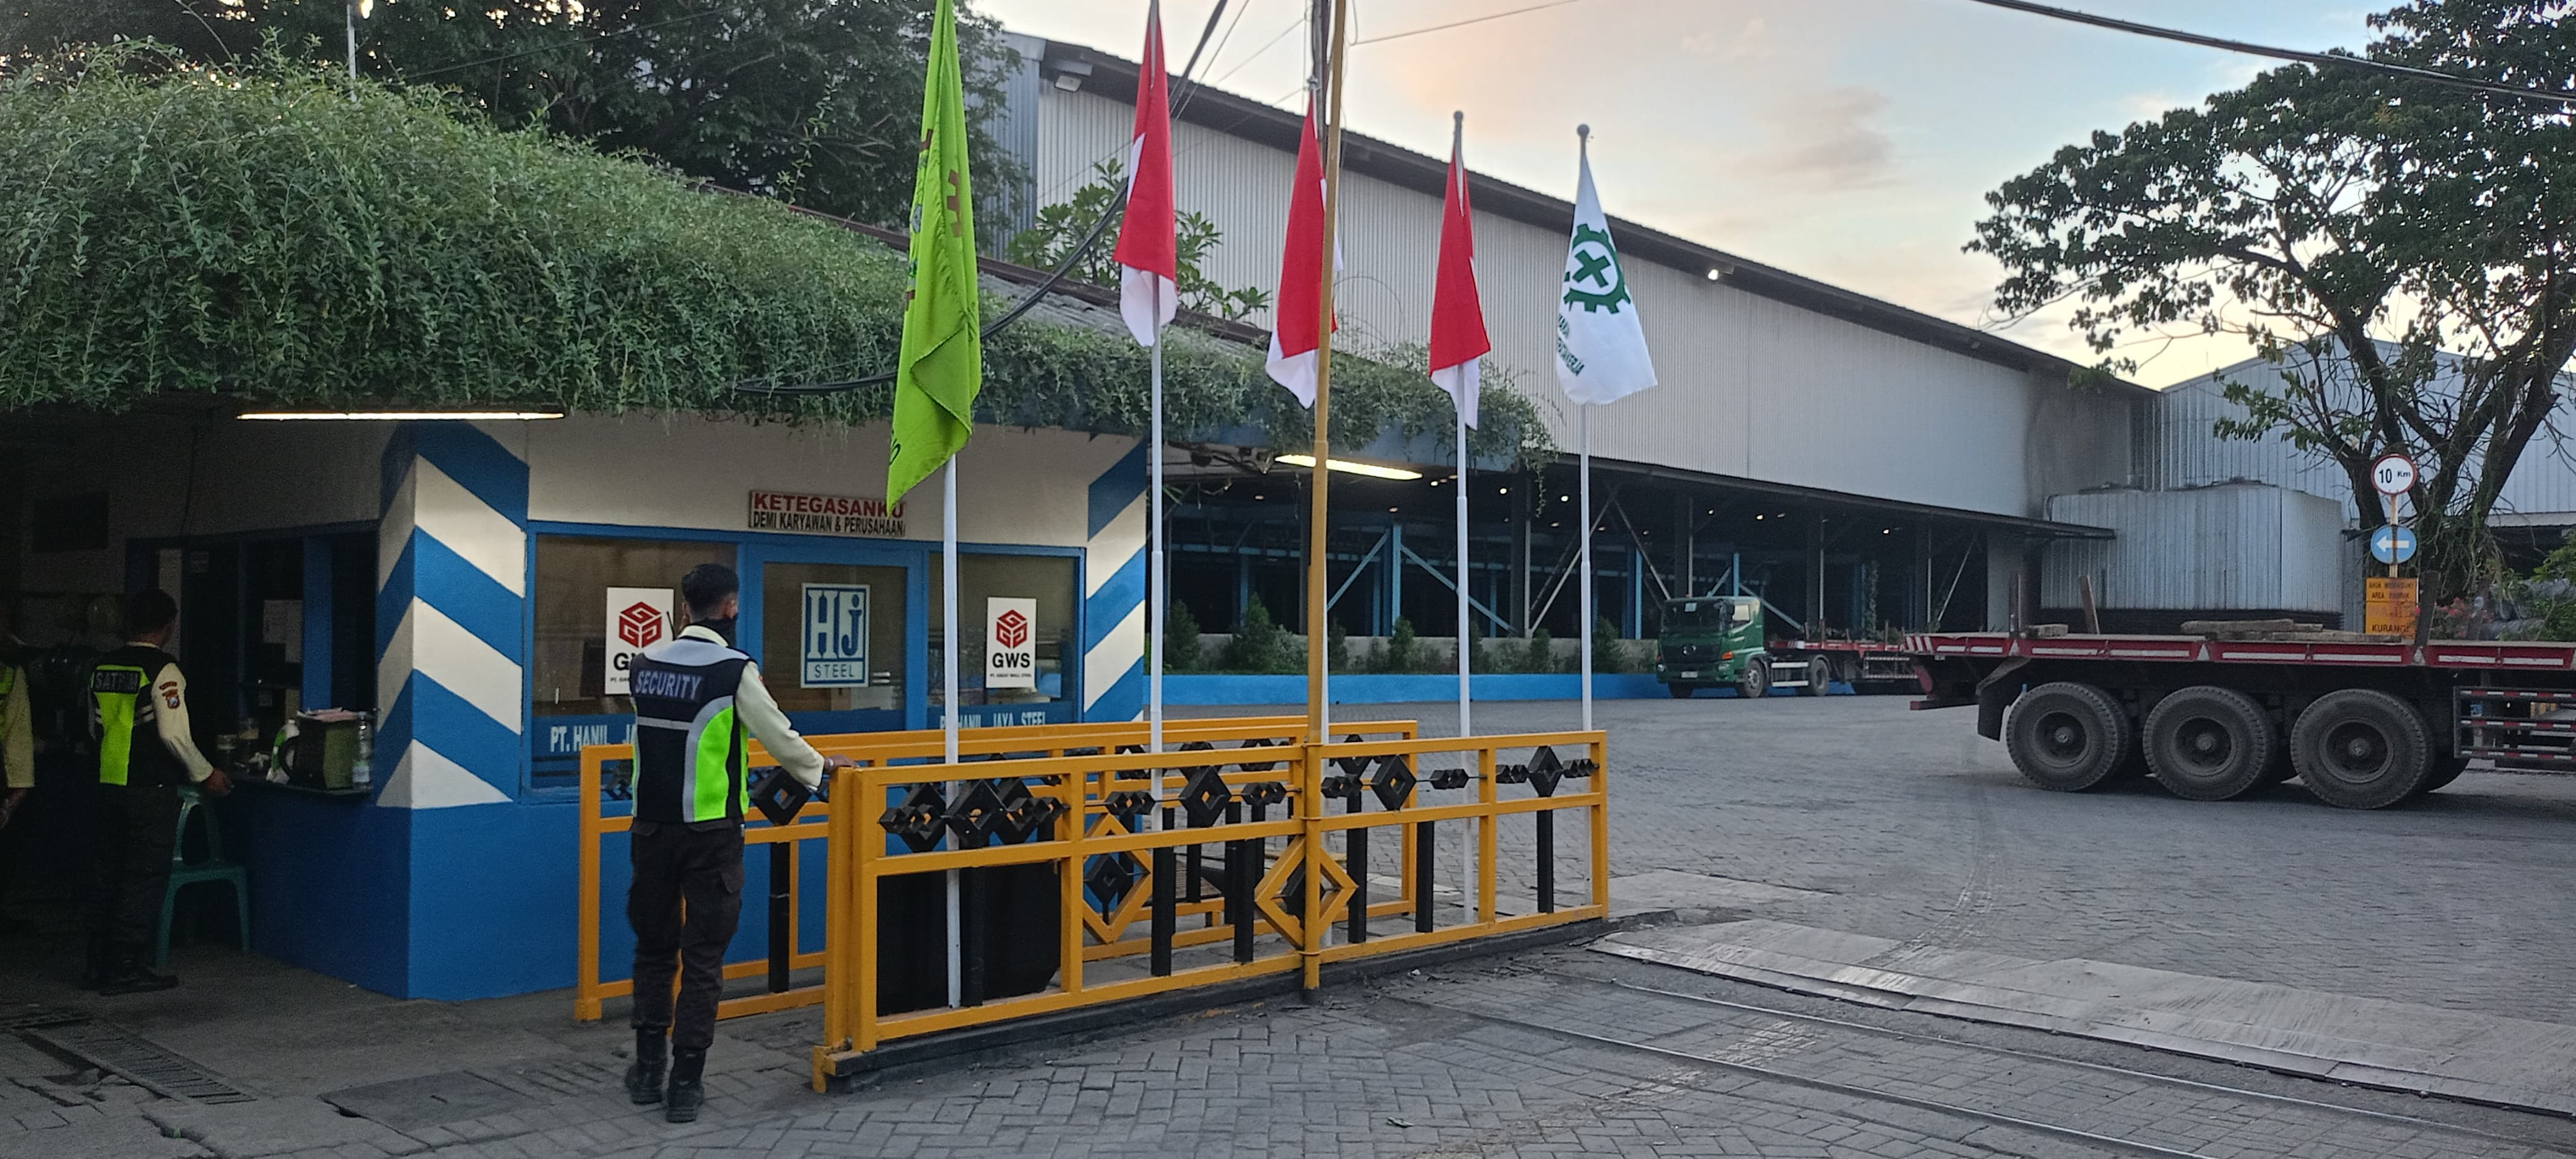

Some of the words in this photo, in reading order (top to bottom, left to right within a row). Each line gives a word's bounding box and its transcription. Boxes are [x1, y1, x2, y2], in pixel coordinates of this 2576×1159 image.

[2378, 468, 2392, 483] 10
[753, 510, 777, 528] DEMI
[780, 512, 832, 531] KARYAWAN
[835, 515, 841, 531] &
[844, 517, 903, 537] PERUSAHAAN
[815, 663, 855, 678] STEEL
[993, 652, 1030, 668] GWS
[635, 670, 702, 699] SECURITY
[550, 726, 570, 753] PT.
